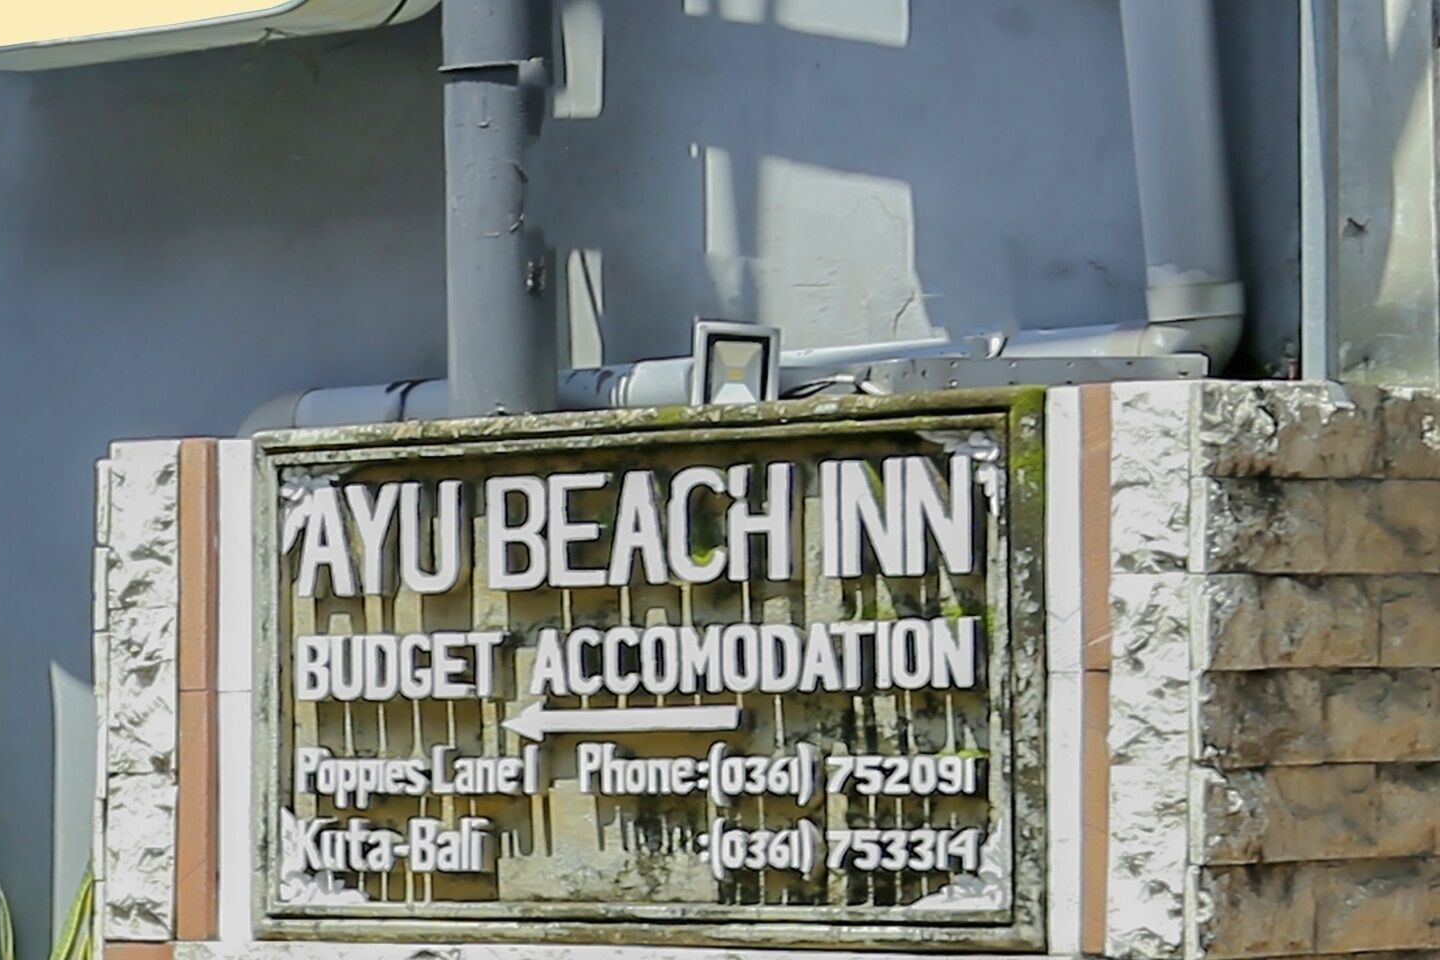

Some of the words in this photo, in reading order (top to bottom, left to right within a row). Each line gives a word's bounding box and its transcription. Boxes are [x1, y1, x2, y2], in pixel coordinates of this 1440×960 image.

[297, 478, 462, 598] AYU
[486, 462, 794, 591] BEACH
[819, 454, 975, 578] INN
[297, 631, 508, 702] BUDGET
[530, 616, 981, 697] ACCOMODATION
[296, 746, 432, 809] Poppies
[826, 754, 977, 796] 752091
[826, 826, 980, 871] 753314
